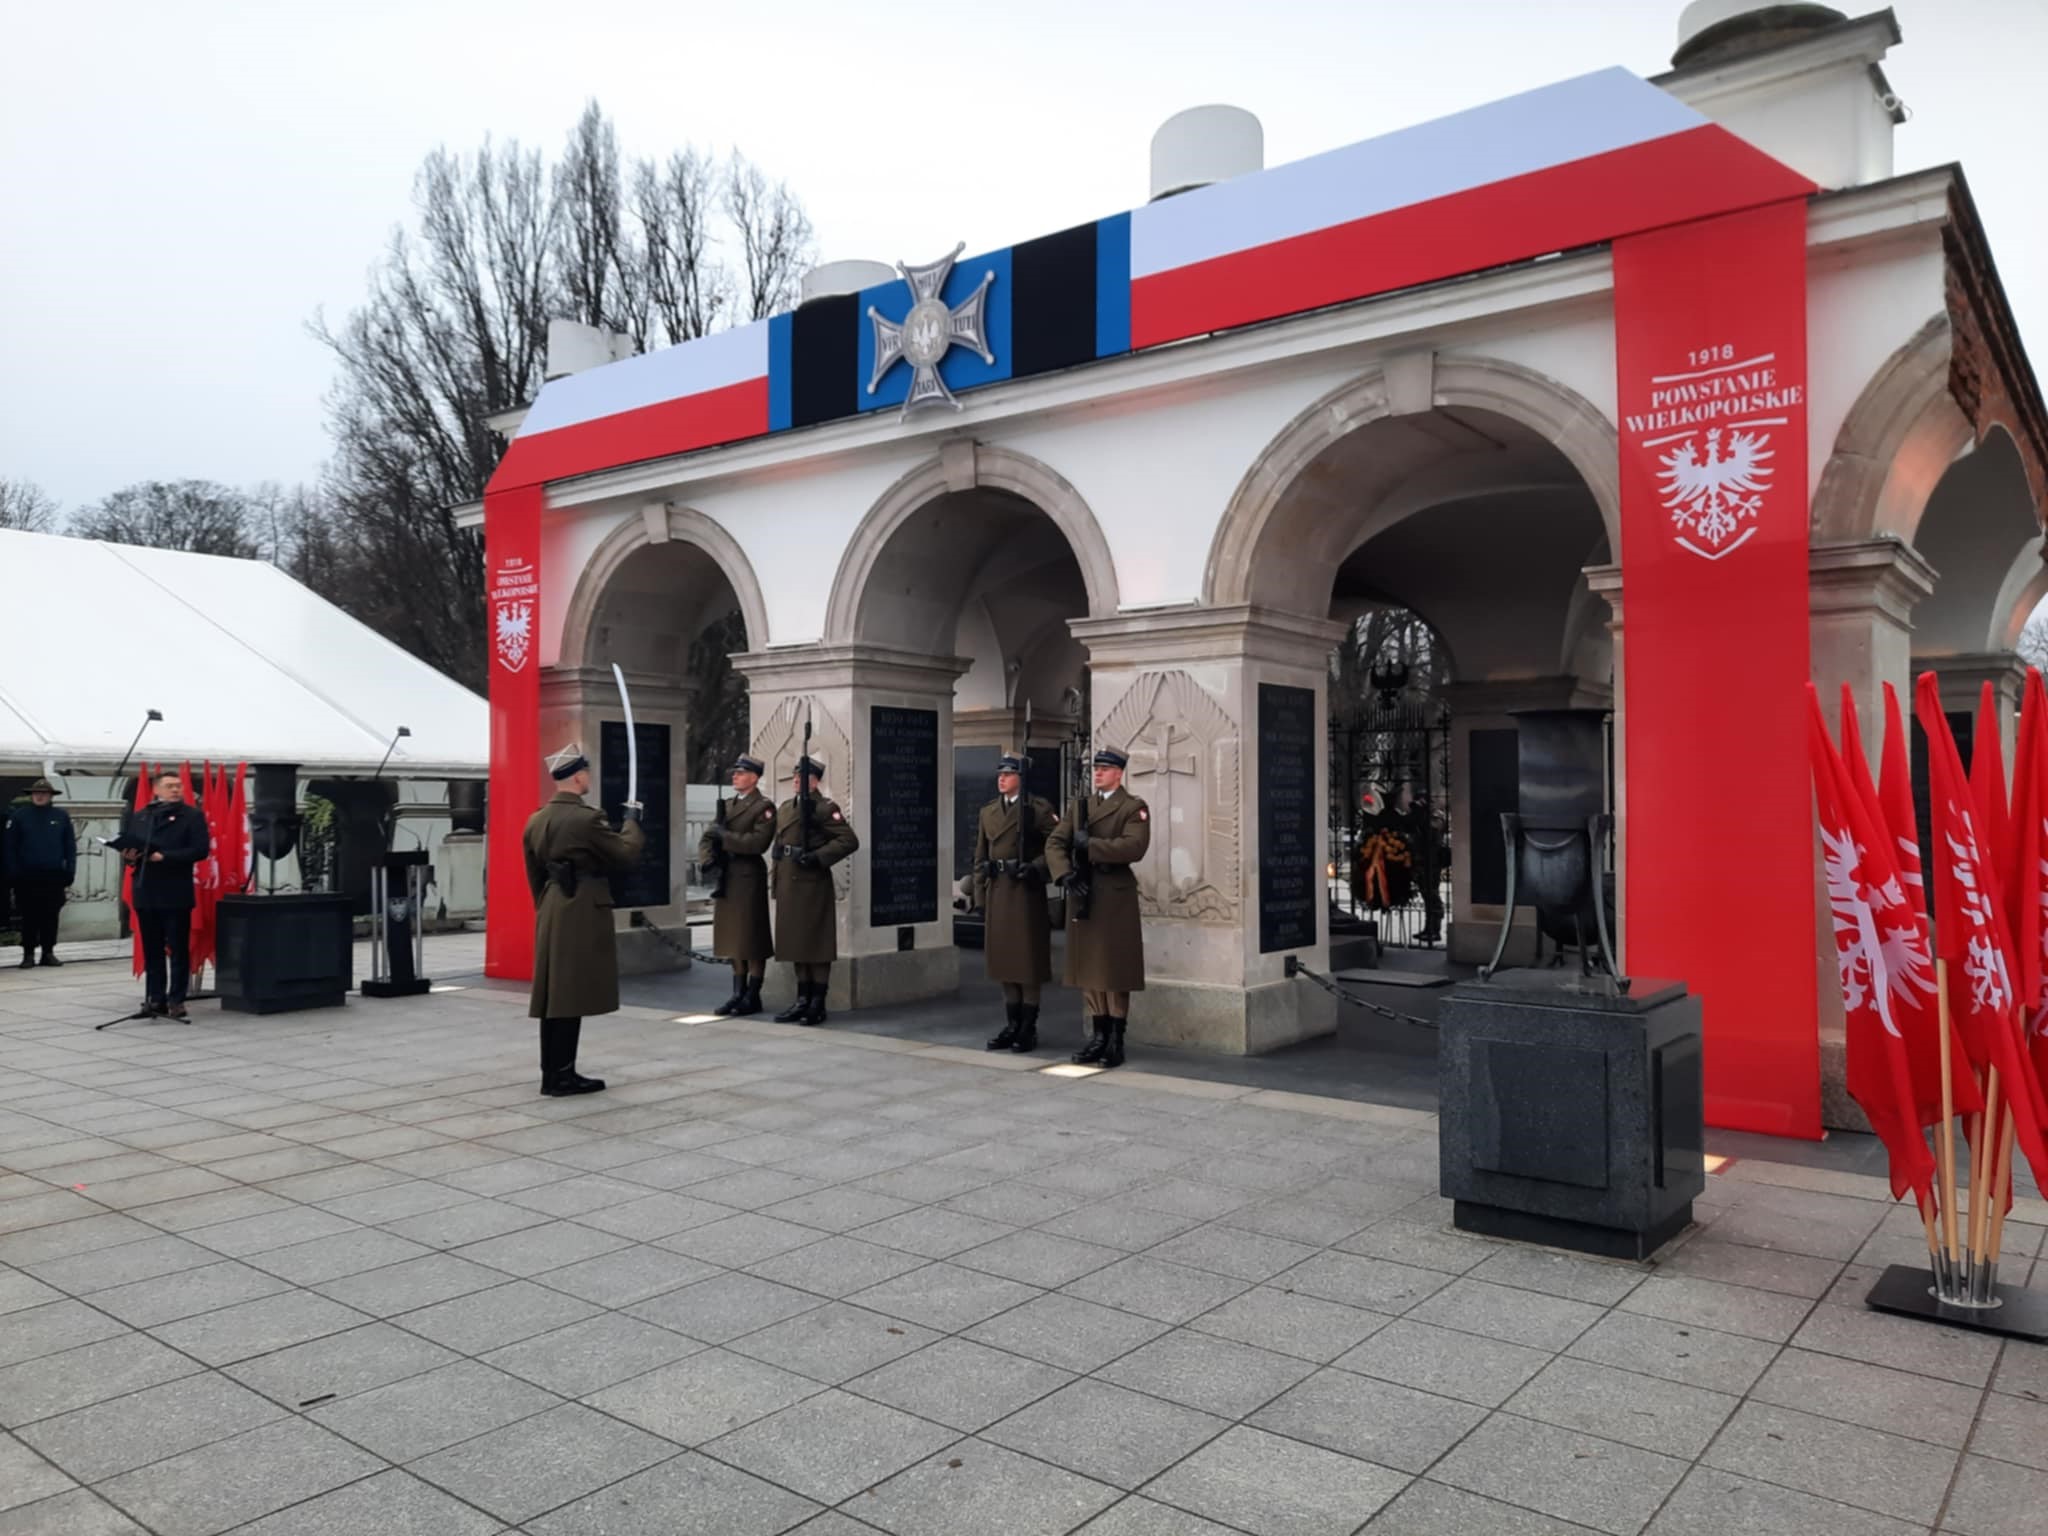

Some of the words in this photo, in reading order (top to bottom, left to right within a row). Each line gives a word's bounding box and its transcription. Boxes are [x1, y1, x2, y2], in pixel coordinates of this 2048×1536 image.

[1688, 344, 1734, 366] 1918
[1651, 368, 1776, 408] POWSTANIE
[1625, 385, 1803, 432] WIELKOPOLSKIE
